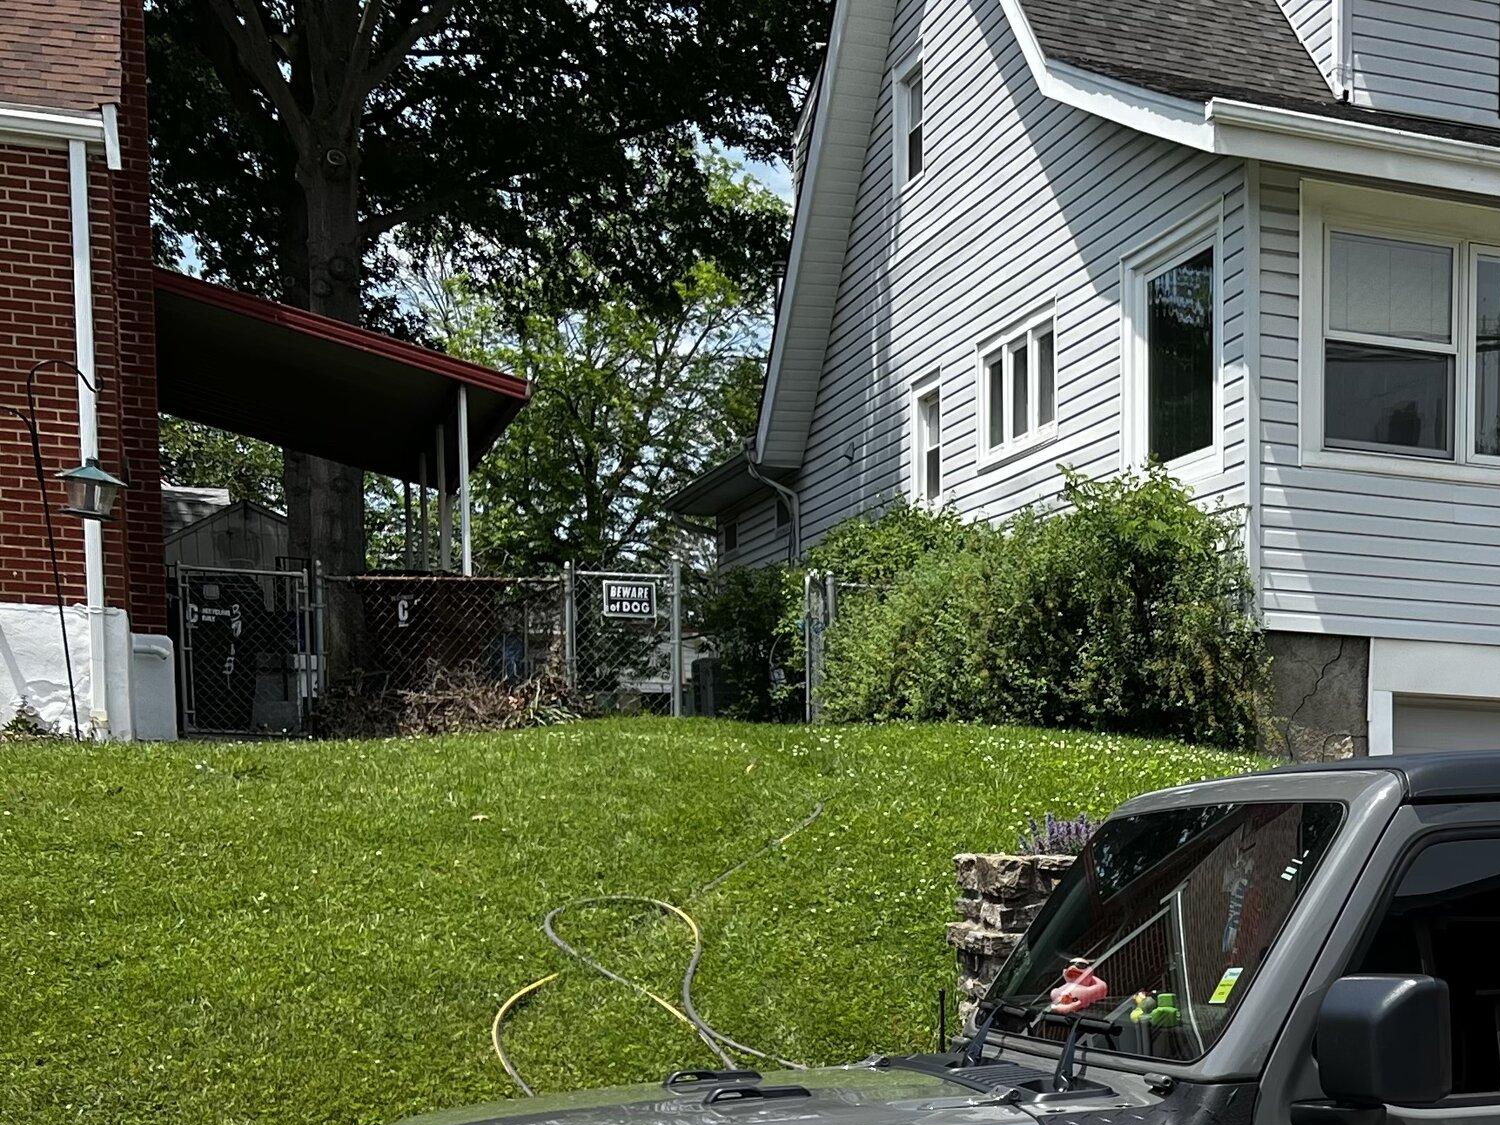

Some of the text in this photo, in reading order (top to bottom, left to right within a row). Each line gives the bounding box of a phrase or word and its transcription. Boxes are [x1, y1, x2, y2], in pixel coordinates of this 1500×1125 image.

[610, 586, 649, 599] BEWARE
[610, 601, 650, 613] of DOG
